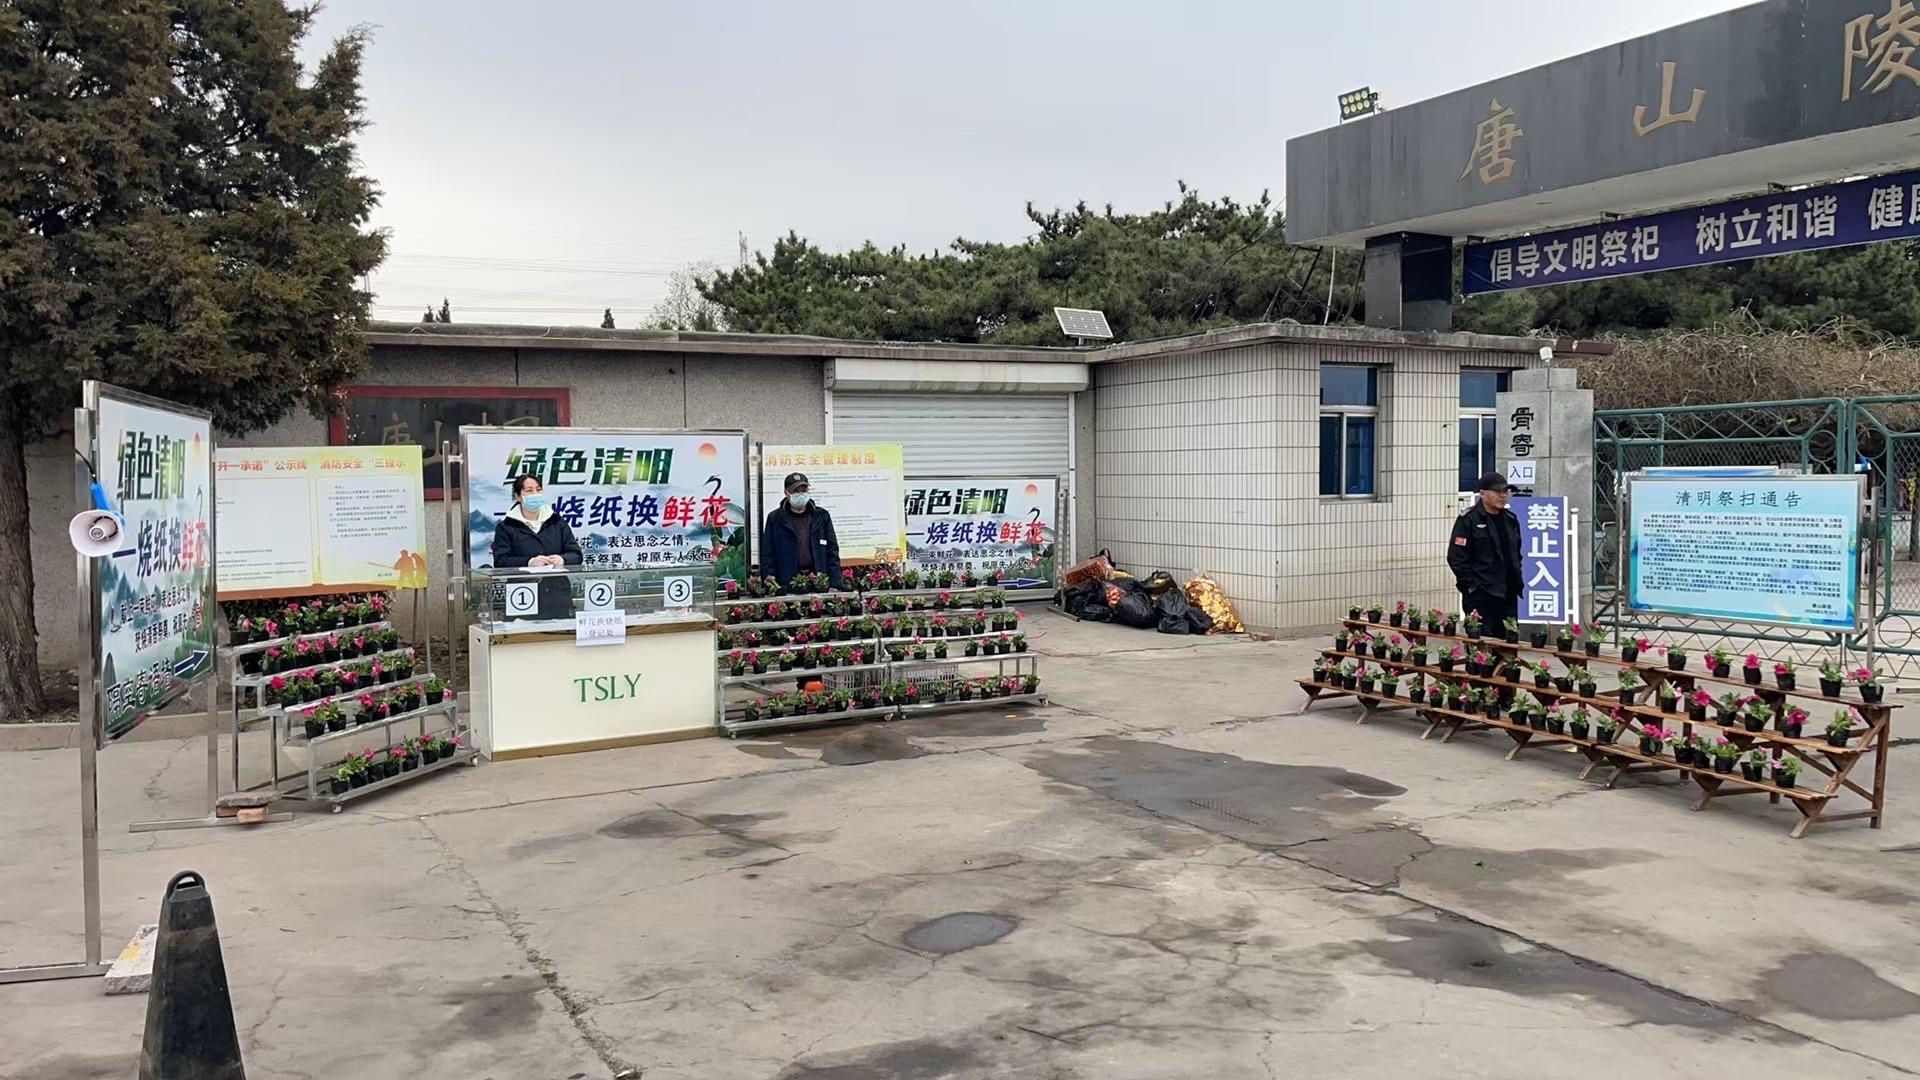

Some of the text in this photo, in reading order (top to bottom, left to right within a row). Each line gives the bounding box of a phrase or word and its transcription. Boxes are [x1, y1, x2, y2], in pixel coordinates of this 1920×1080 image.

[1489, 225, 1660, 283] 倡导文明祭祀
[1695, 194, 1838, 255] 树立和谐
[116, 429, 186, 501] 绿色清明
[502, 446, 674, 486] 绿色清明
[765, 452, 877, 467] 消防安全管理制度
[1509, 465, 1534, 478] 入口
[494, 494, 732, 529] 烧纸换鲜花
[904, 488, 1009, 516] 绿色清明
[1675, 490, 1802, 508] 清明祭扫通告
[1527, 503, 1560, 618] 禁止入园
[573, 673, 643, 703] TSLY
